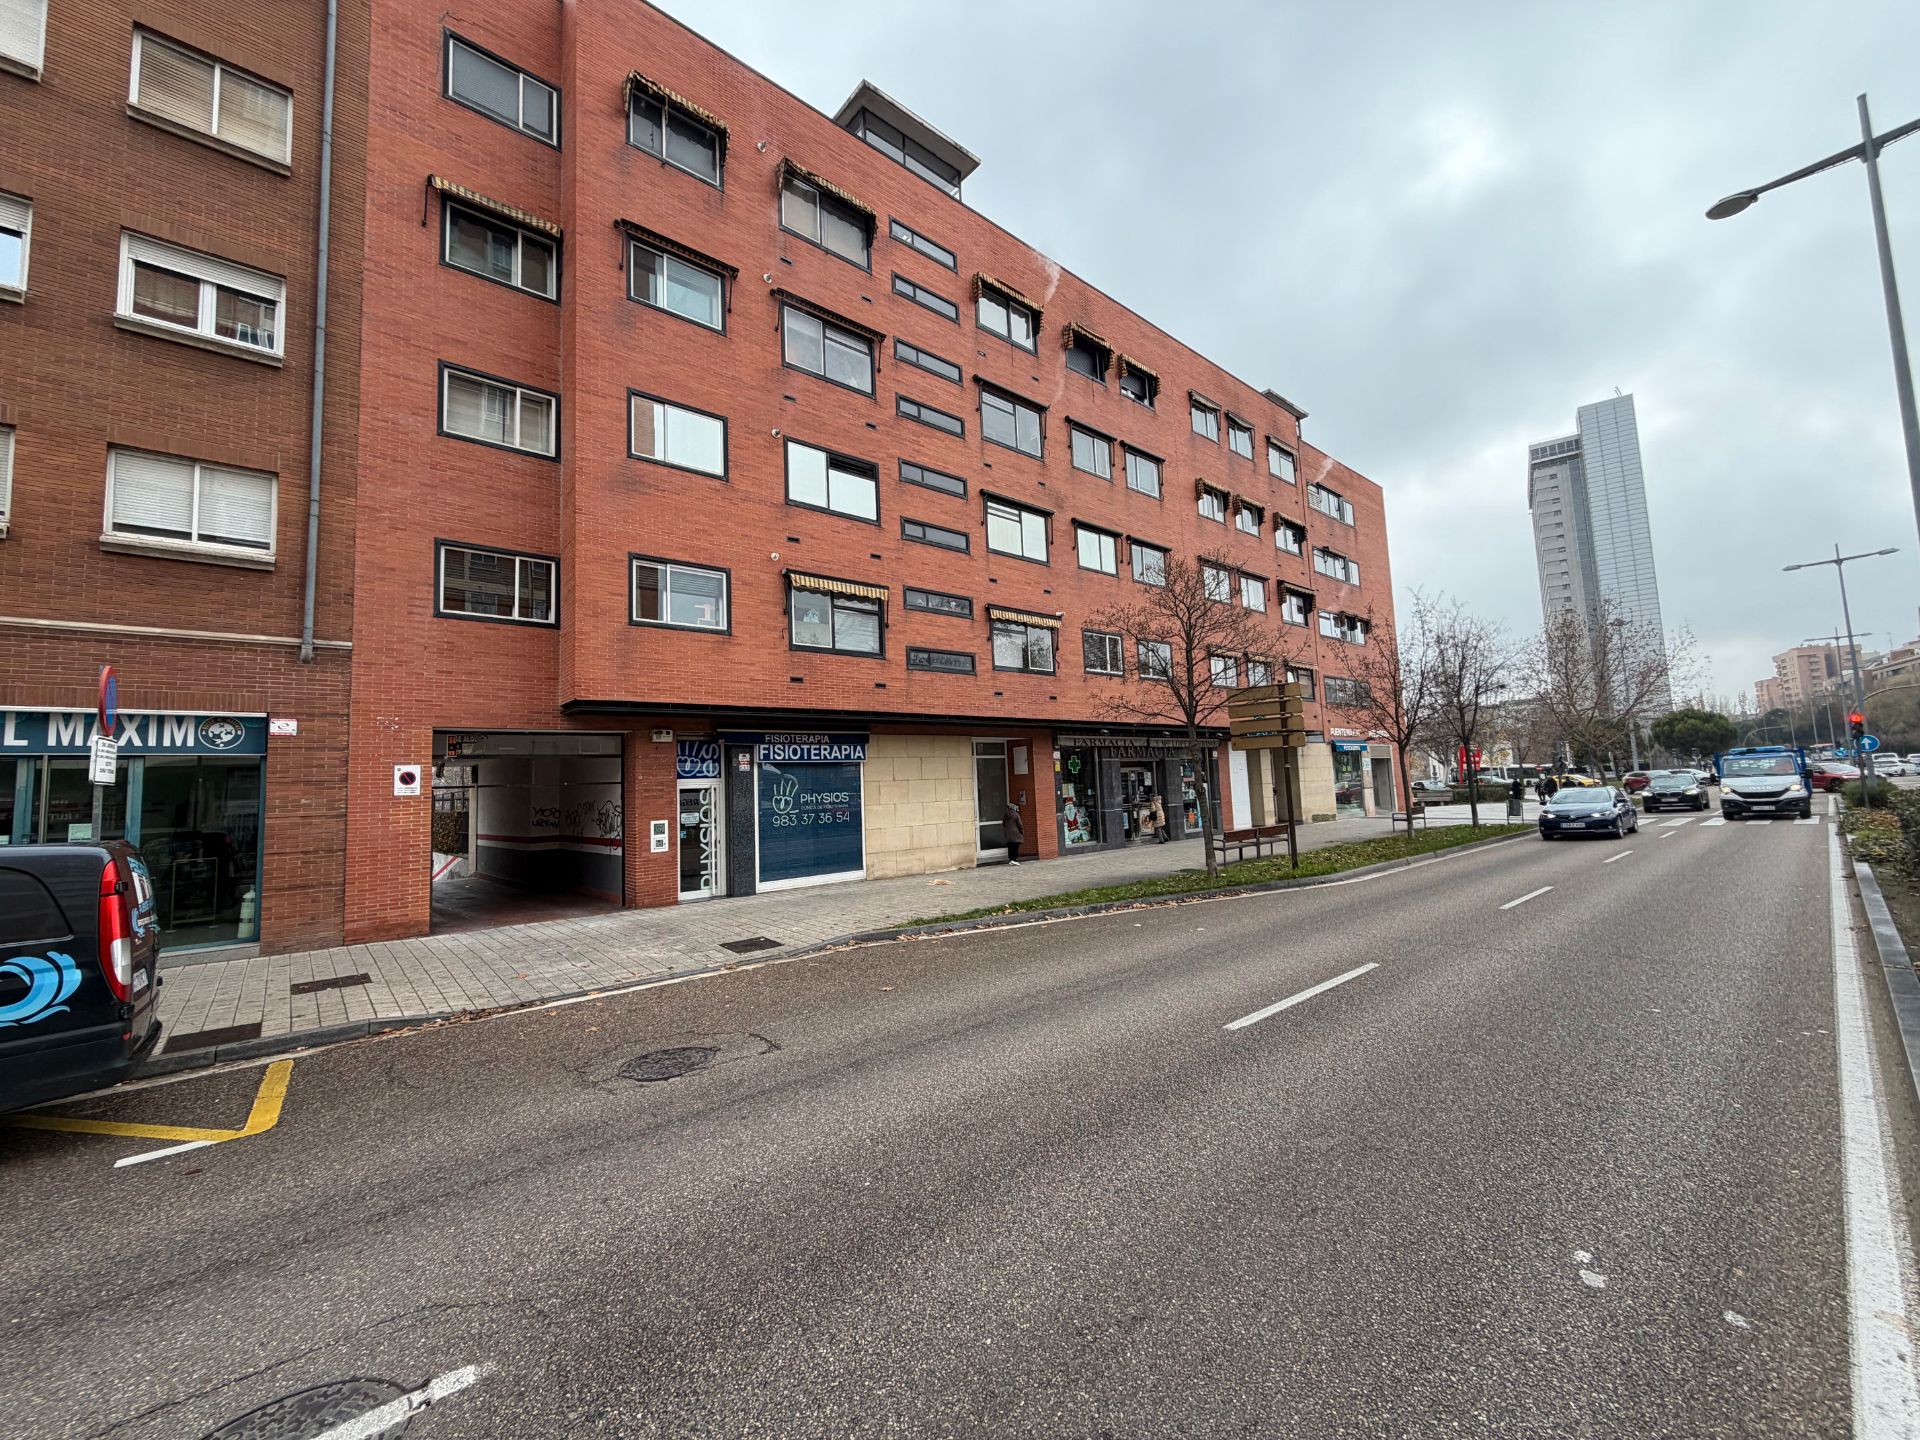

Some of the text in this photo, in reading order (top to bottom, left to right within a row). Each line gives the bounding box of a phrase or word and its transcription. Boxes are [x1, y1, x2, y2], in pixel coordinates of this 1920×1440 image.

[765, 734, 830, 743] FISIOTERAPIA
[1073, 738, 1134, 746] FARMACIA
[760, 745, 864, 760] FISIOTERAPIA
[1110, 746, 1176, 758] FARMACIA
[800, 792, 849, 804] PHYSIOS
[772, 811, 850, 827] 983 37 36 54
